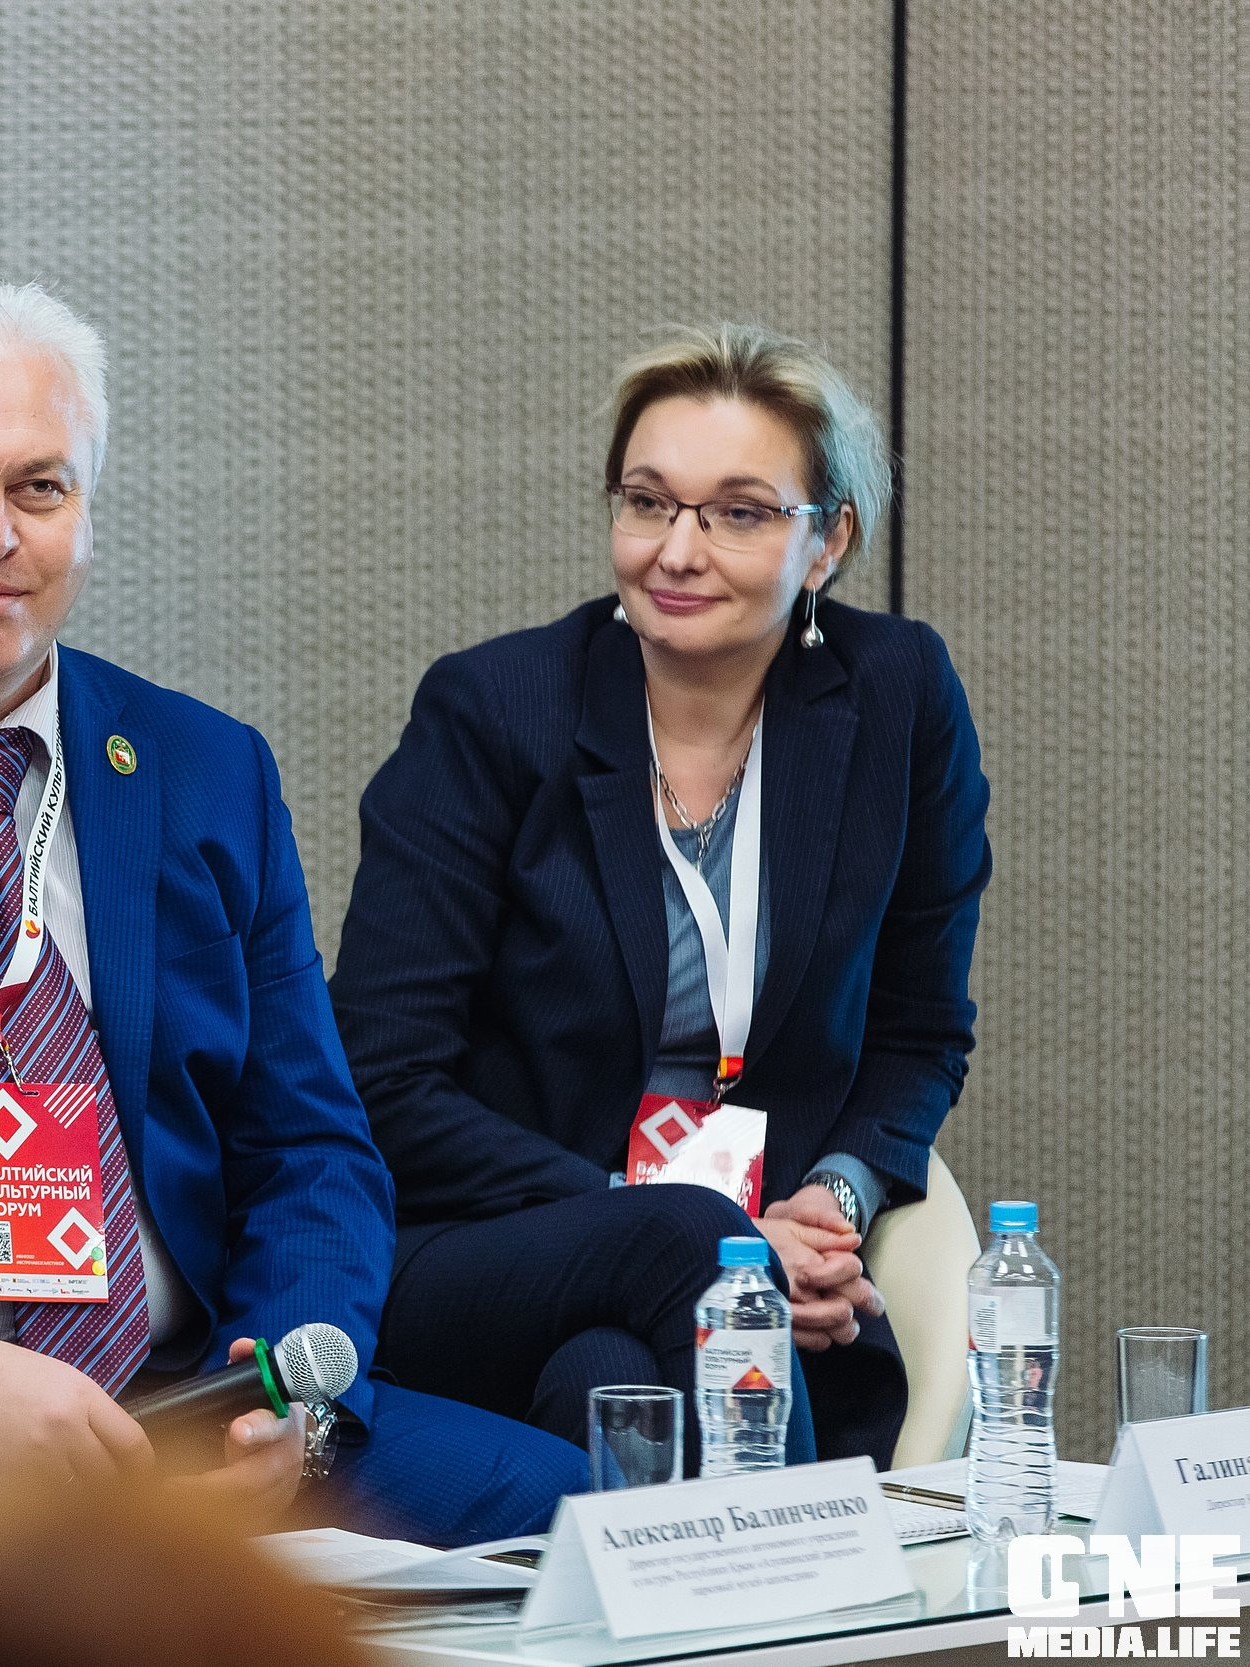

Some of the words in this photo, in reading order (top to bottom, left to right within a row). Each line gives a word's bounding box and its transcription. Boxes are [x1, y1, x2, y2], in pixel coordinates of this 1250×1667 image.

[28, 813, 54, 917] БАЛТИЙСКИЙ
[1174, 1456, 1250, 1484] Галин
[603, 1516, 726, 1551] Александр
[726, 1496, 869, 1533] Балинченко
